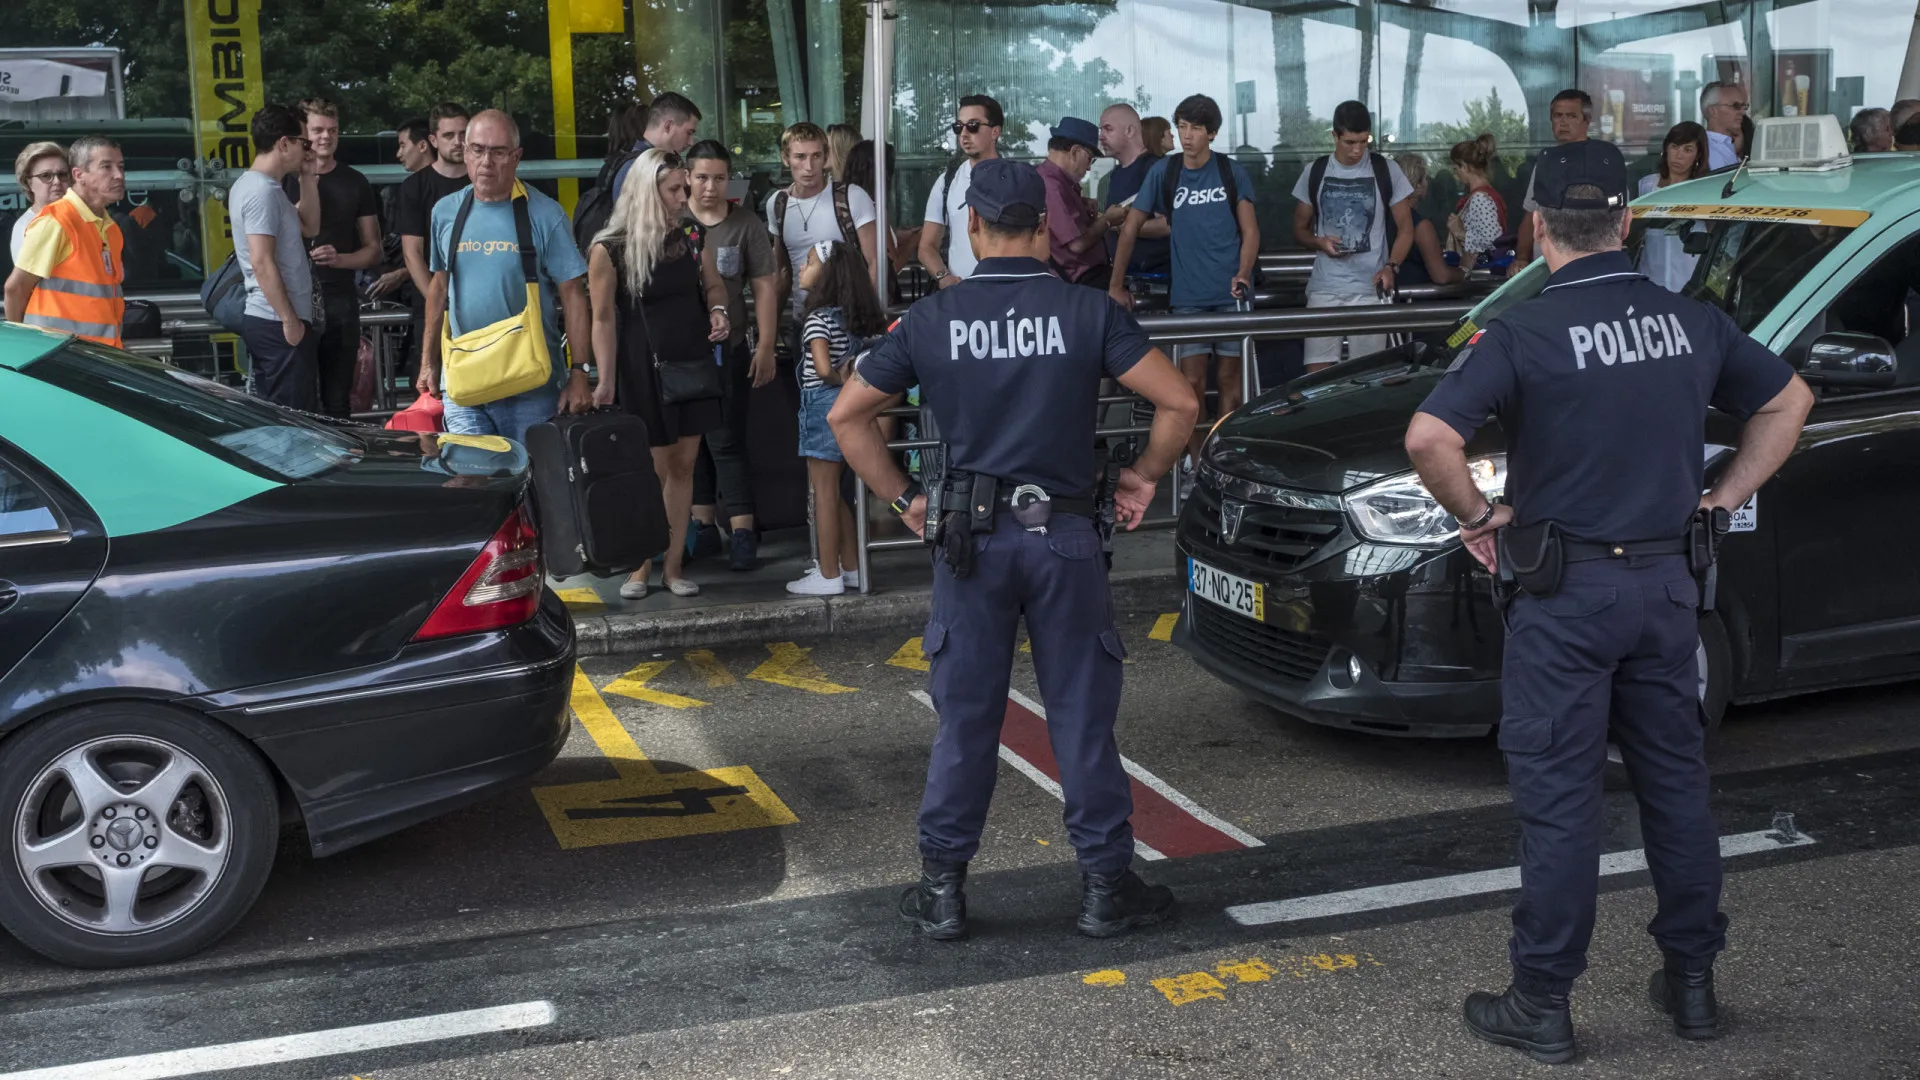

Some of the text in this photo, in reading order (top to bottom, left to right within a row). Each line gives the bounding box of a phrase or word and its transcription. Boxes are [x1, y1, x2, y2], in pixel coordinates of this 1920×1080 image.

[1710, 206, 1732, 214] 21
[1732, 207, 1764, 215] 793
[1762, 208, 1787, 216] 27
[1786, 209, 1812, 217] 56
[949, 307, 1067, 361] POLÍCIA
[1568, 304, 1693, 370] POLÍCIA
